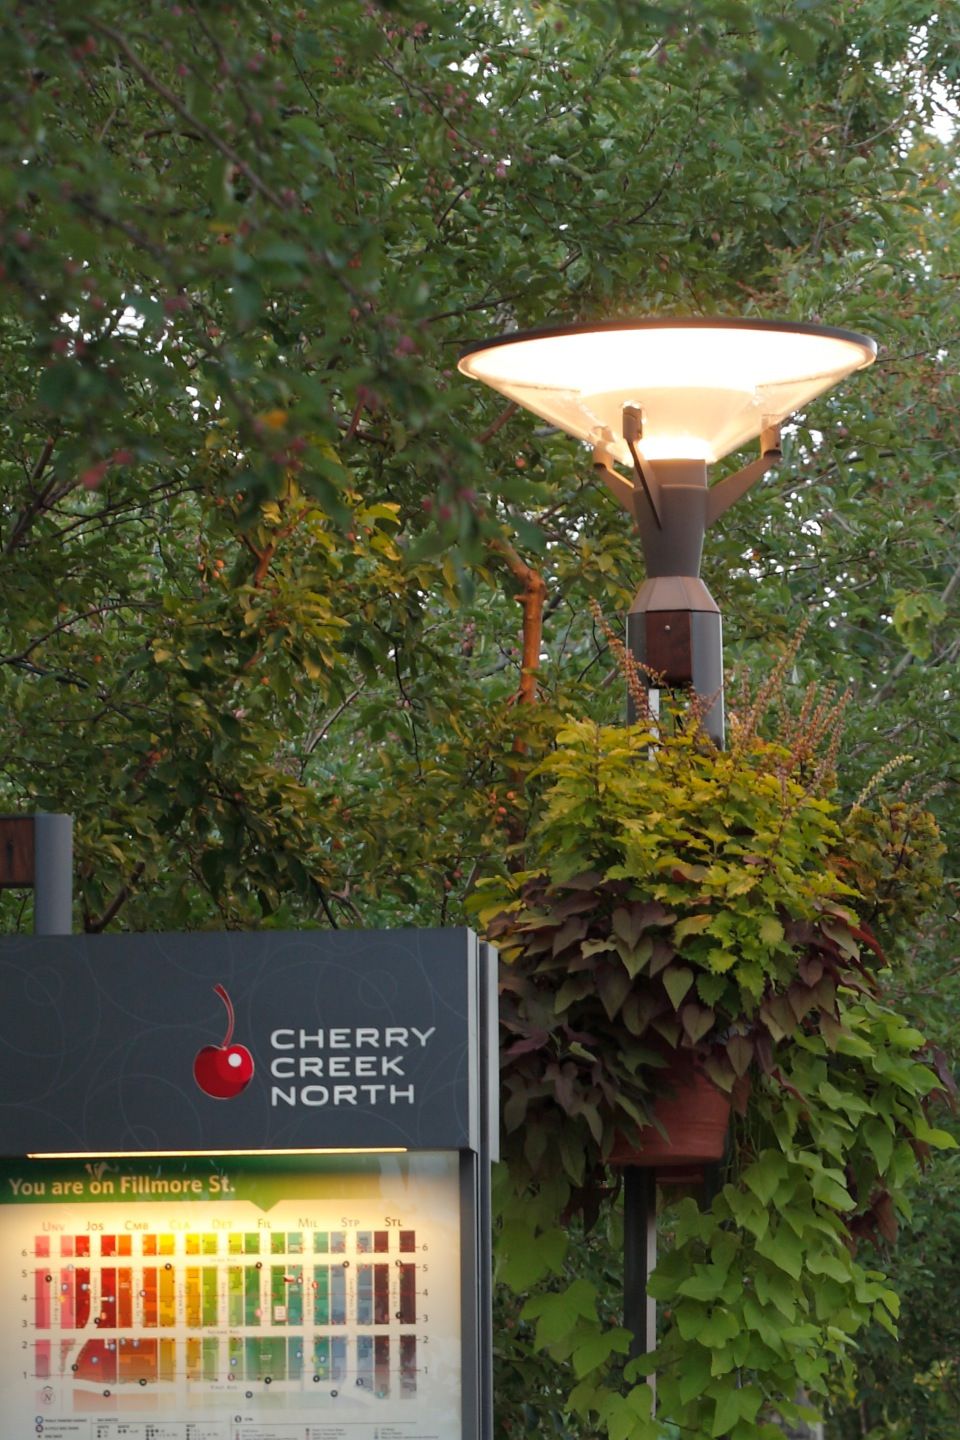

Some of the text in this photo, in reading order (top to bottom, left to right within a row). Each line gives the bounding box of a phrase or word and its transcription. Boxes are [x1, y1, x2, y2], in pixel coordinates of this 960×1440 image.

[270, 1027, 436, 1050] CHERRY
[270, 1056, 405, 1078] CREEK
[271, 1085, 415, 1107] NORTH
[8, 1175, 235, 1196] You are on Fillmore St.
